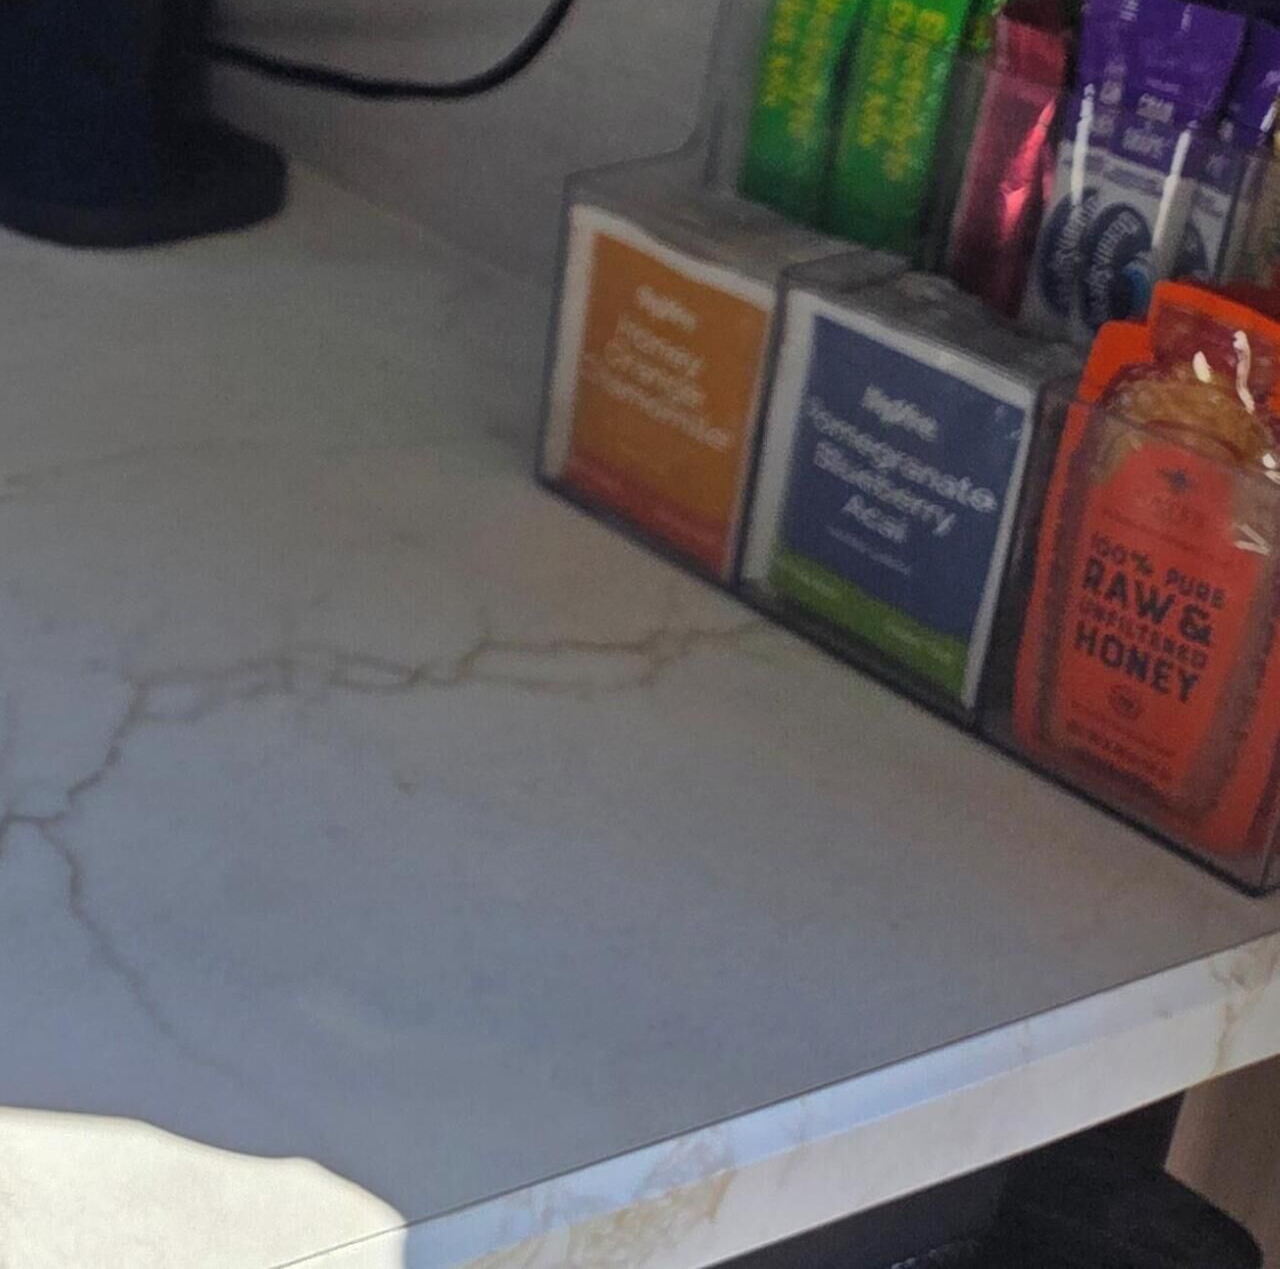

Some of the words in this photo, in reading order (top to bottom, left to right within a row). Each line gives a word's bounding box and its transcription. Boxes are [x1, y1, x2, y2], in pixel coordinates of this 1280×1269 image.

[1081, 557, 1176, 625] RAW
[1165, 565, 1229, 609] PURE
[1073, 619, 1200, 704] HONEY
